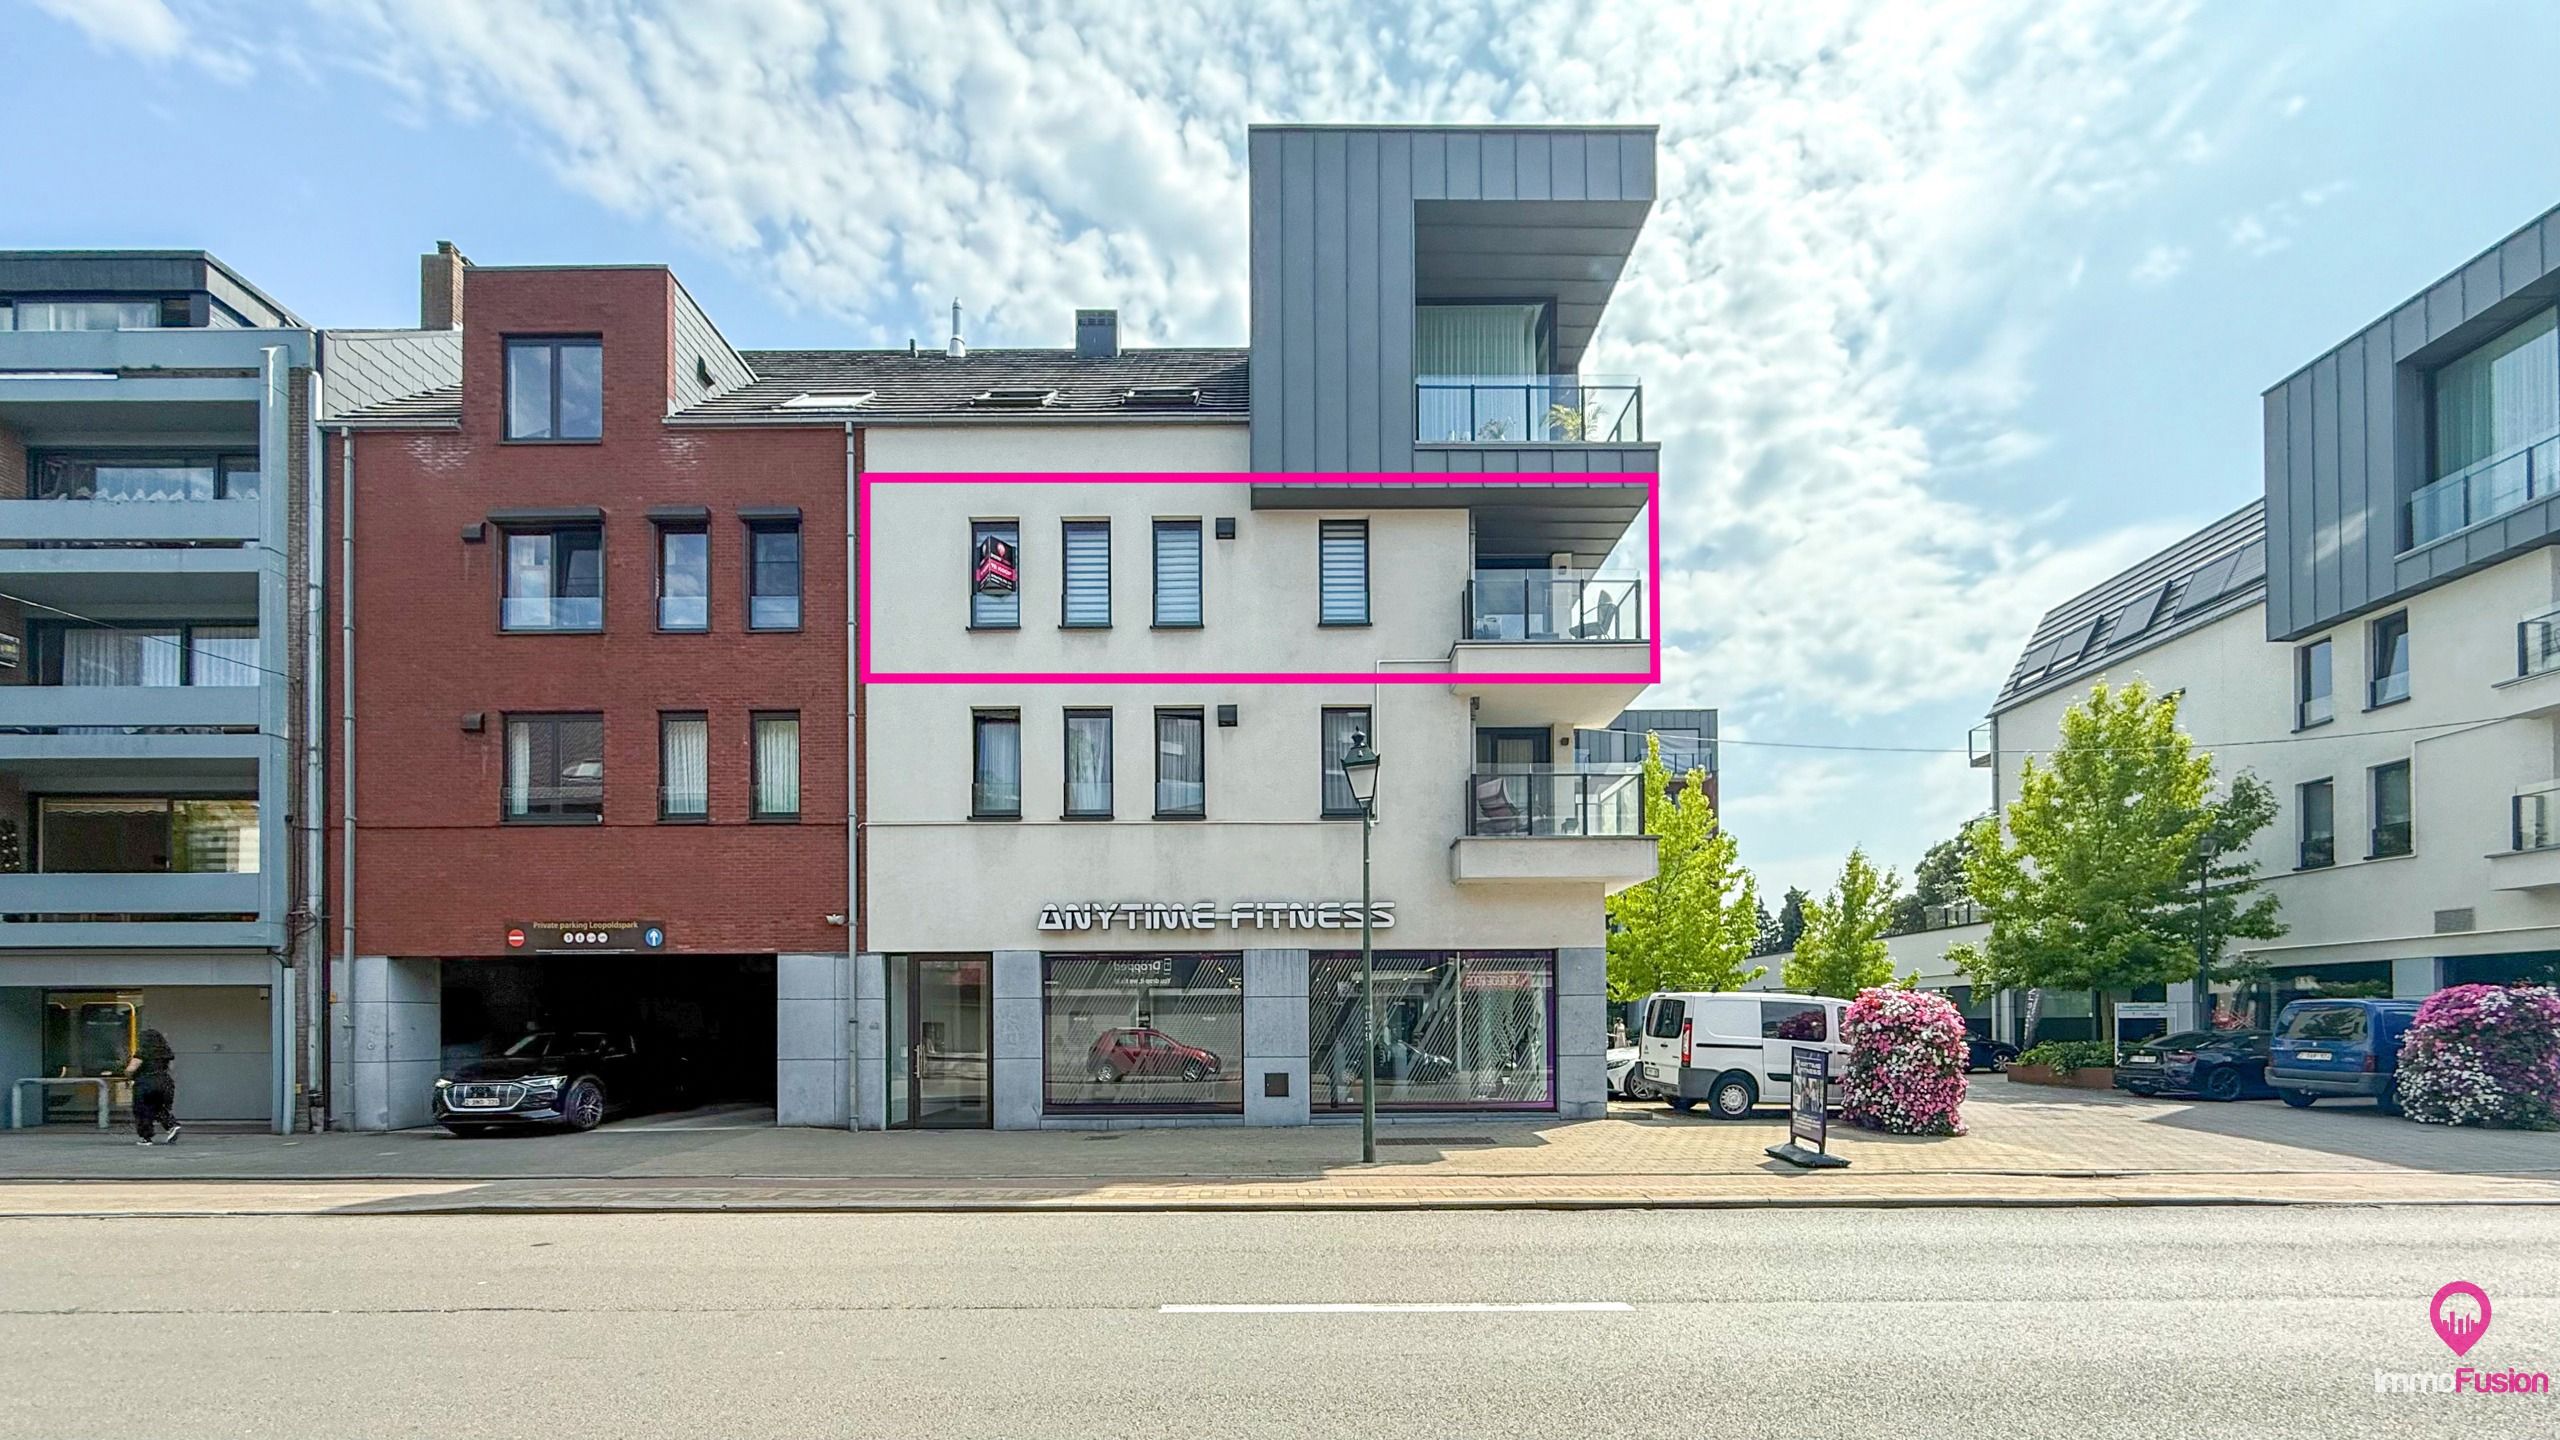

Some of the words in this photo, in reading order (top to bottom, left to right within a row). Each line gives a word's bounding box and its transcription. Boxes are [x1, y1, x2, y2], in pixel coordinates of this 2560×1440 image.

[533, 921, 558, 929] Private
[559, 921, 588, 930] parking
[589, 921, 638, 930] Leopoldspark
[1037, 902, 1216, 931] ANYTIME
[1231, 901, 1396, 930] FITNESS
